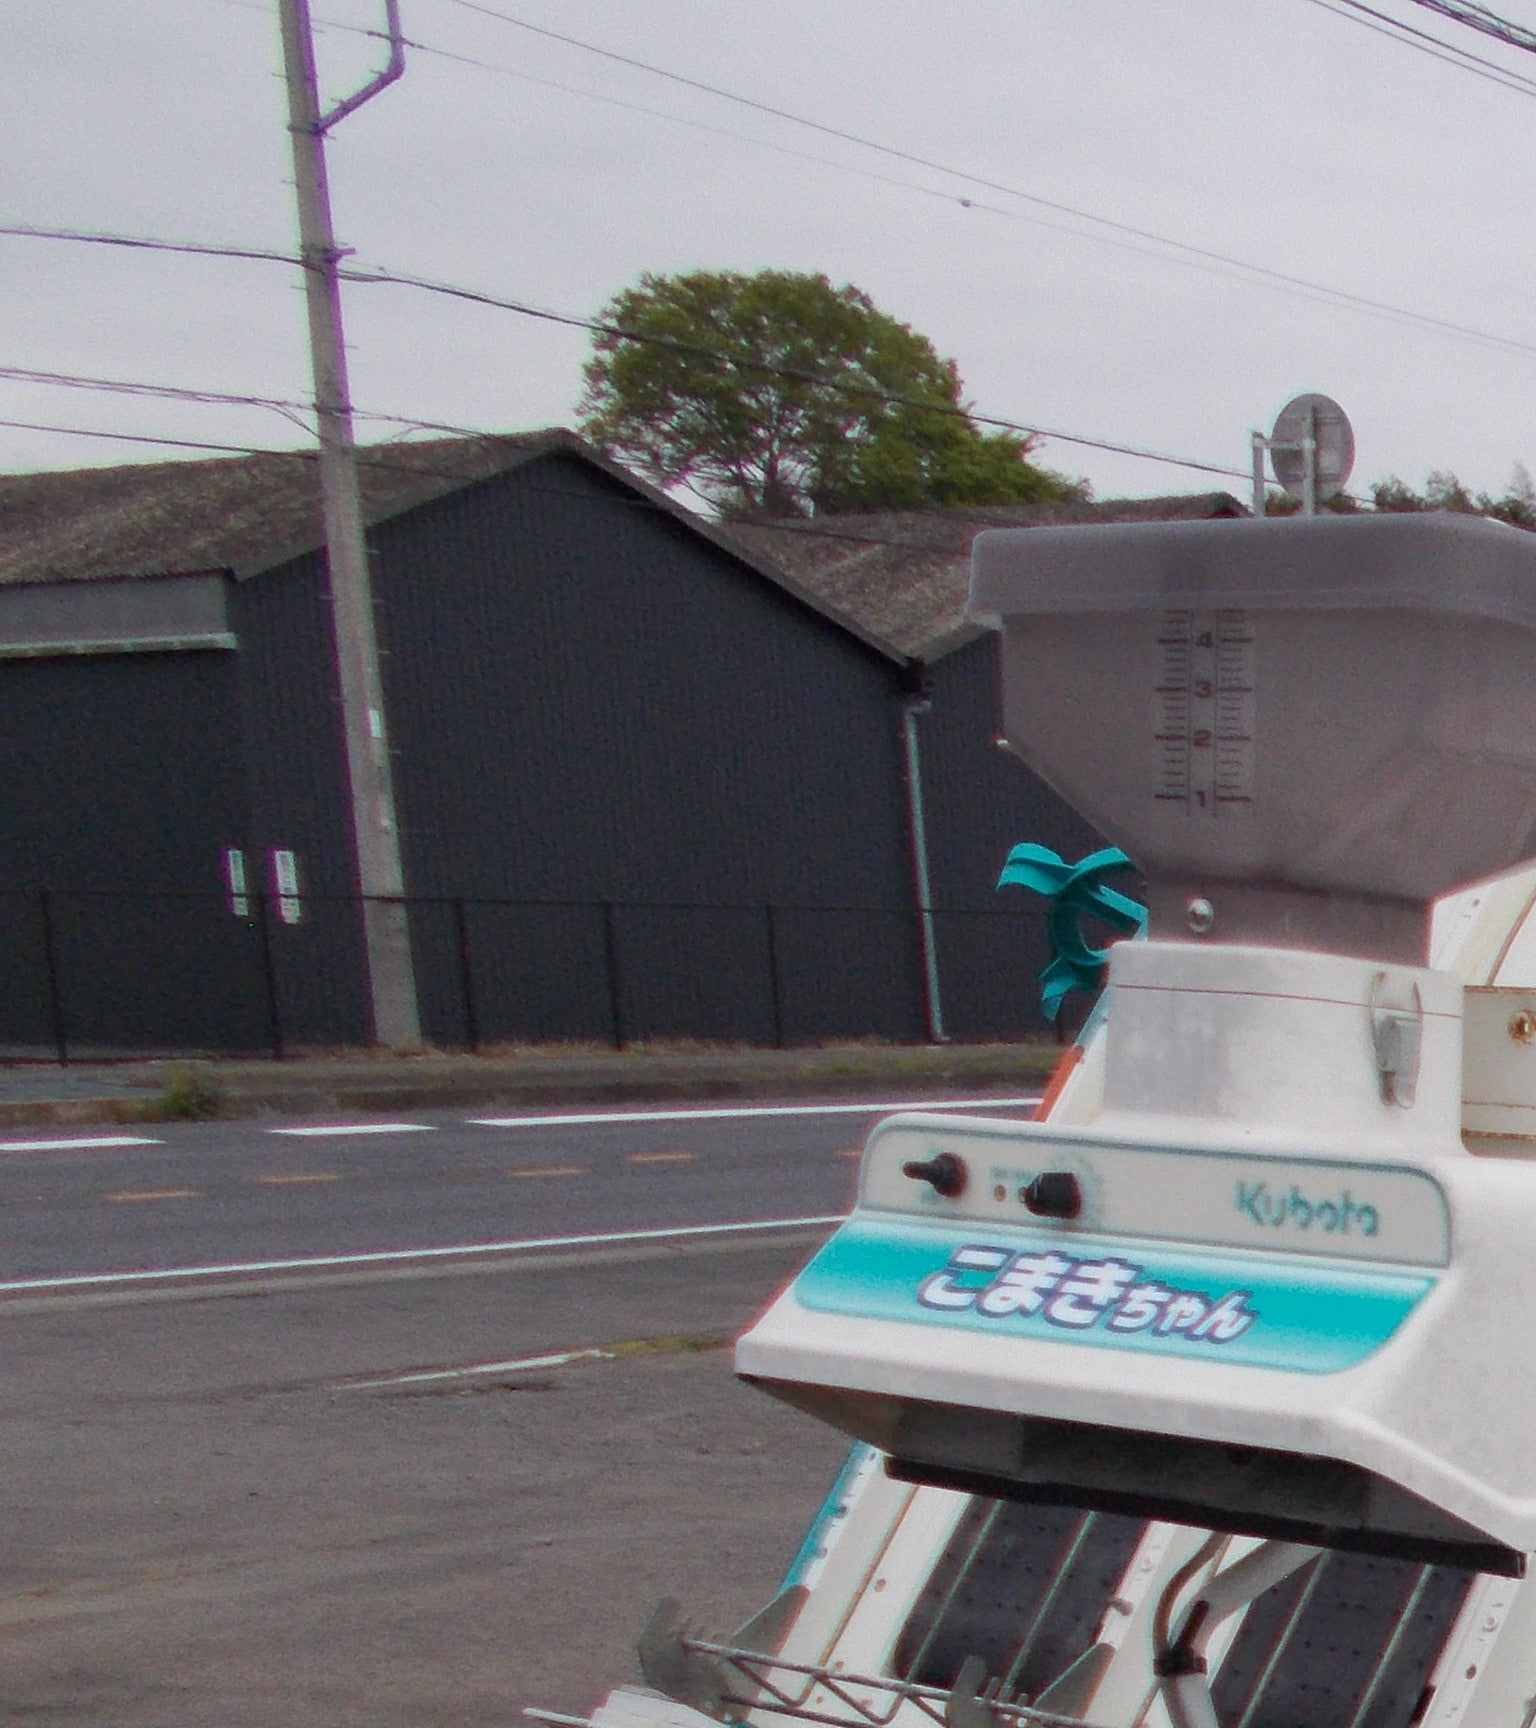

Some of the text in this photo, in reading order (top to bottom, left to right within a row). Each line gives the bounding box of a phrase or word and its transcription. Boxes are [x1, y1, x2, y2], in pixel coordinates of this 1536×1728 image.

[1194, 678, 1213, 698] 3
[1193, 729, 1212, 748] 2
[1233, 1178, 1380, 1237] Kubota
[918, 1244, 1257, 1345] こまきちゃん
